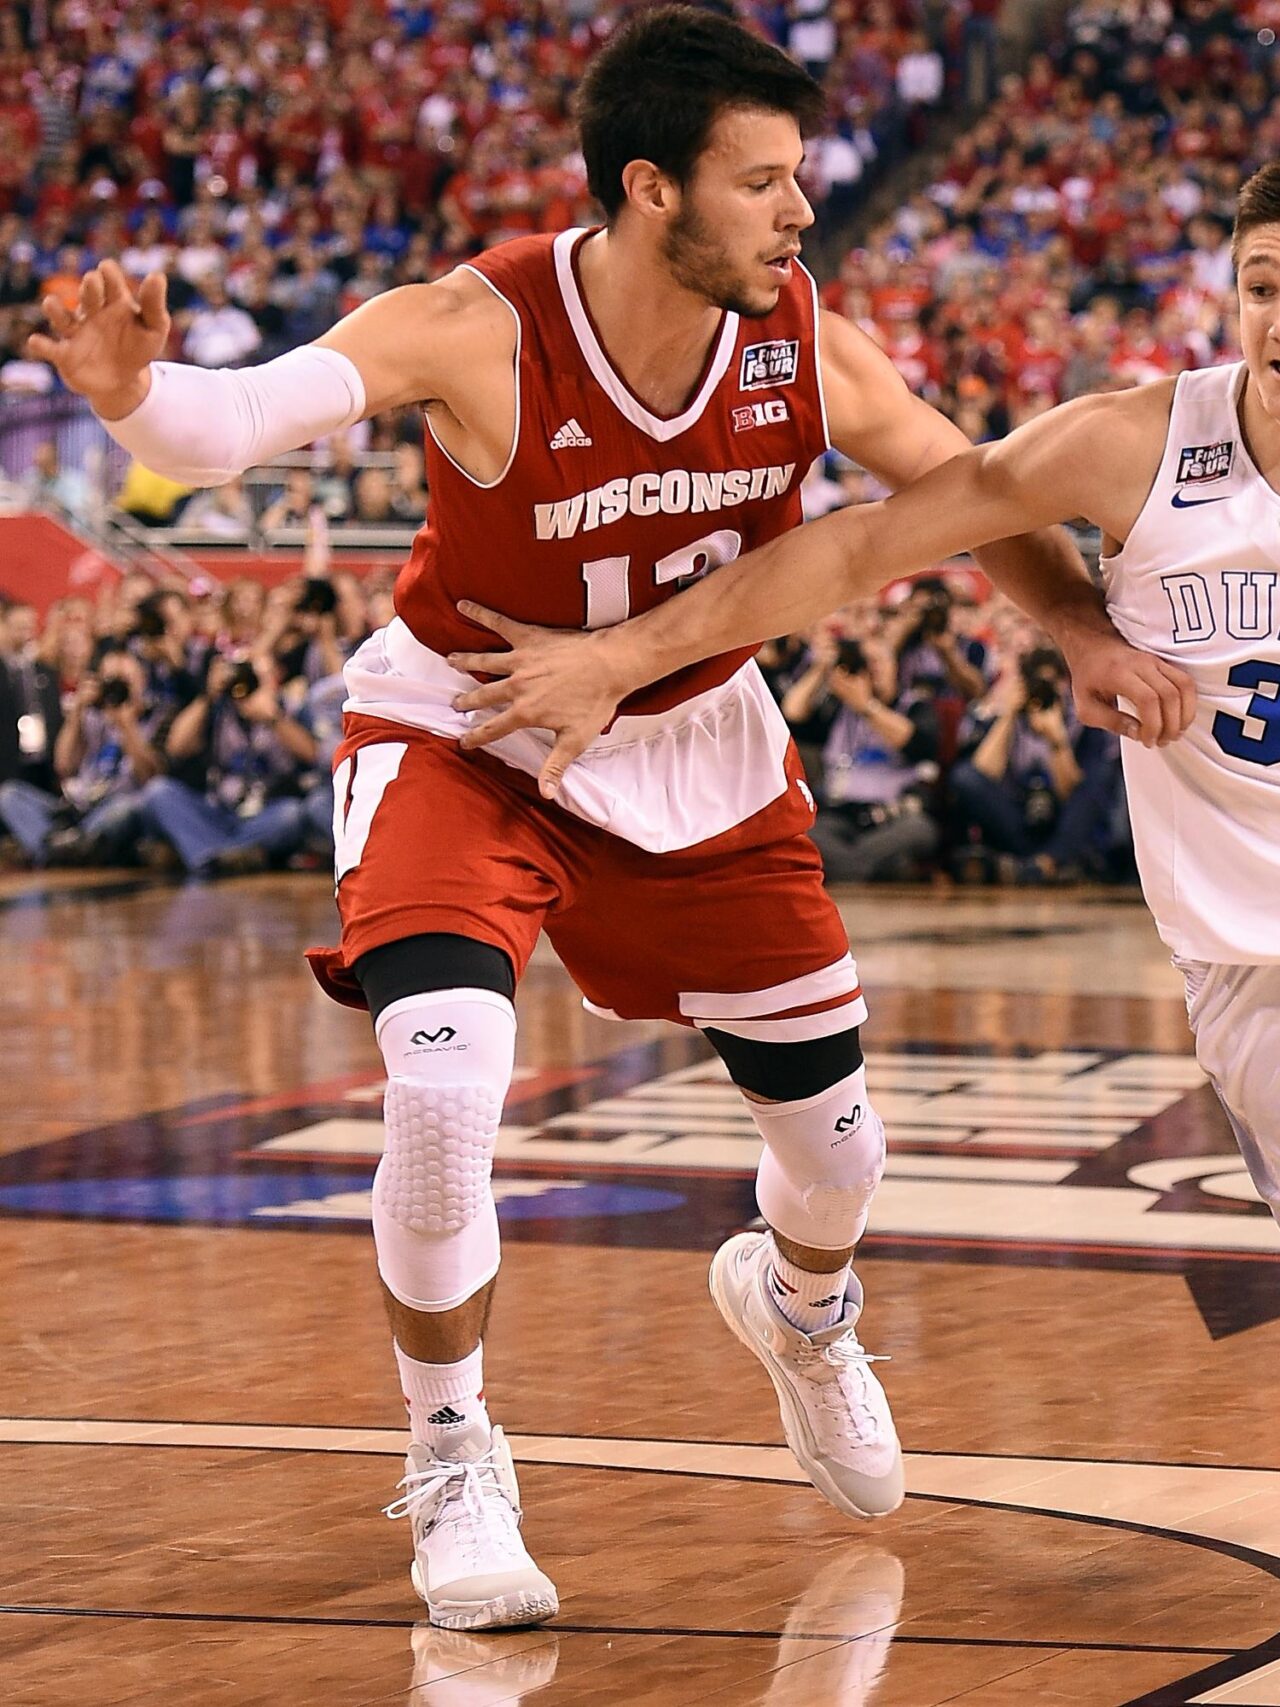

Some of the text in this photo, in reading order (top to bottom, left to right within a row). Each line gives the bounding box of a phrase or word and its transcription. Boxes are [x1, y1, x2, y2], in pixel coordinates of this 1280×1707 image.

[758, 346, 792, 362] FINAL
[746, 357, 793, 383] FOUR
[550, 434, 592, 450] adidas
[1195, 445, 1228, 462] FINAL
[1180, 455, 1229, 479] FOUR
[534, 463, 796, 540] WISCONSIN
